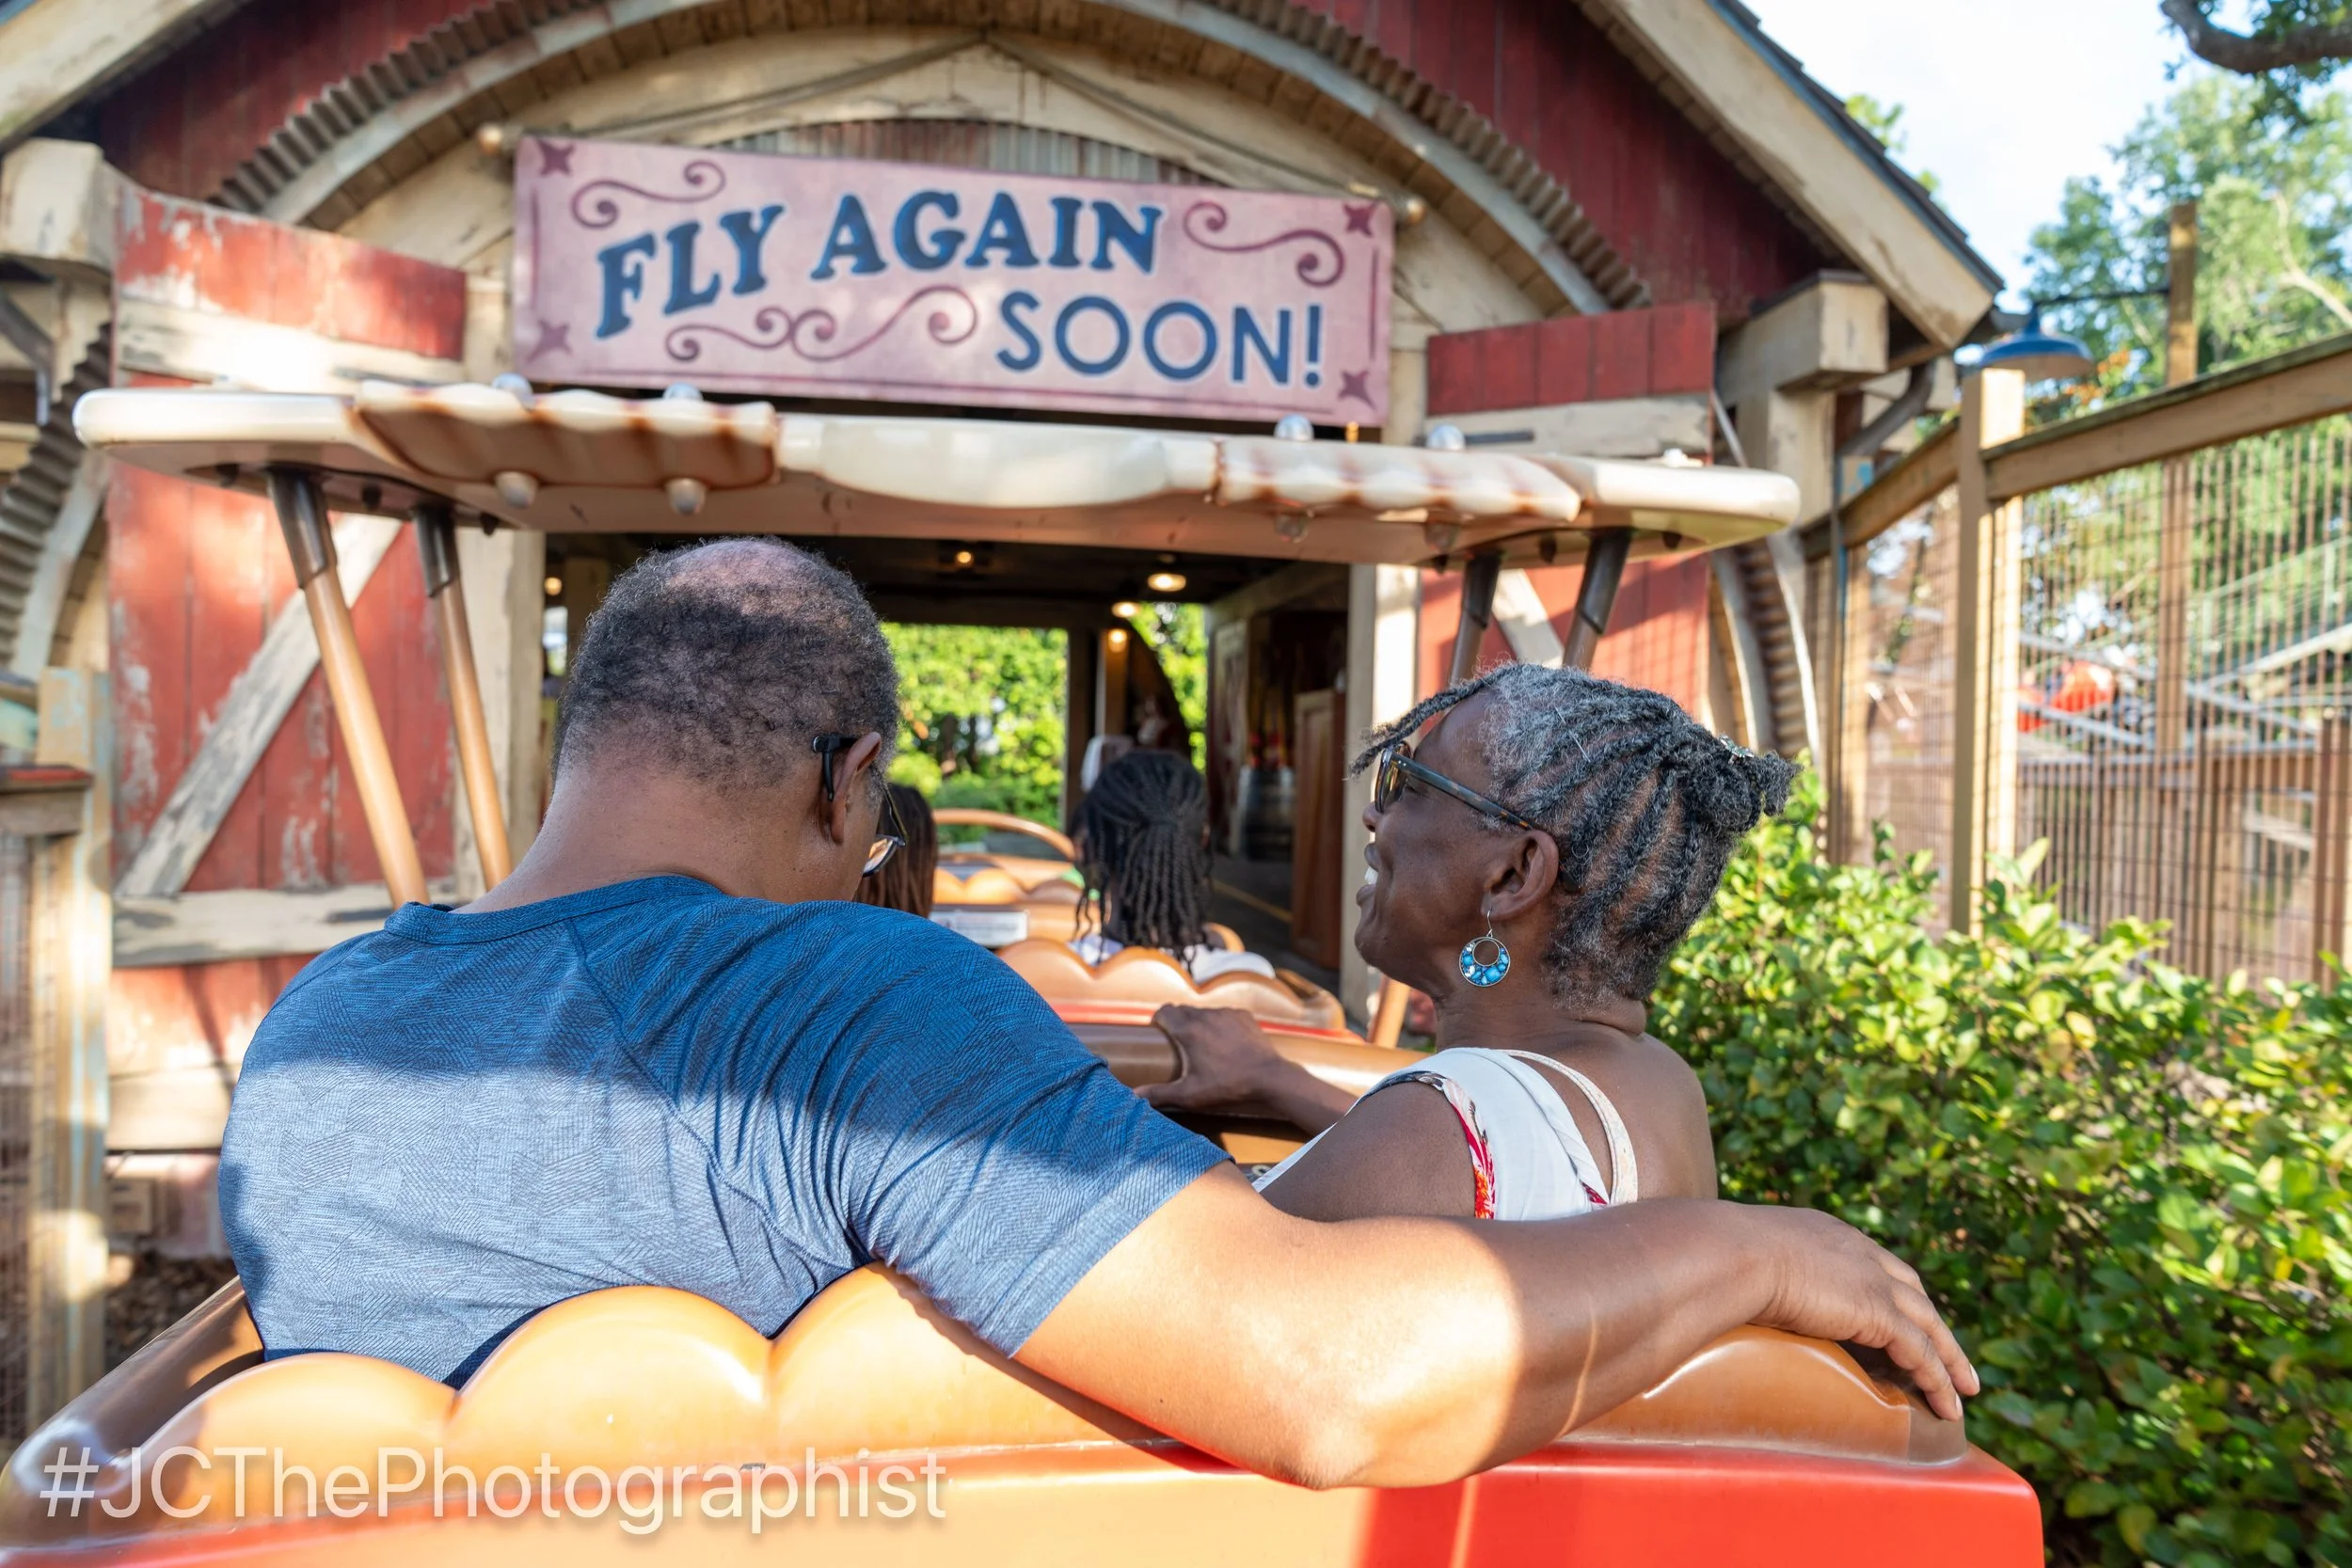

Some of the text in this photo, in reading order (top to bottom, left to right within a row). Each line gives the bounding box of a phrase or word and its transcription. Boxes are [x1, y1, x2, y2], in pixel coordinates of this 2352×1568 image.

[595, 191, 1162, 339] FLY AGAIN
[997, 291, 1323, 388] SOON!
